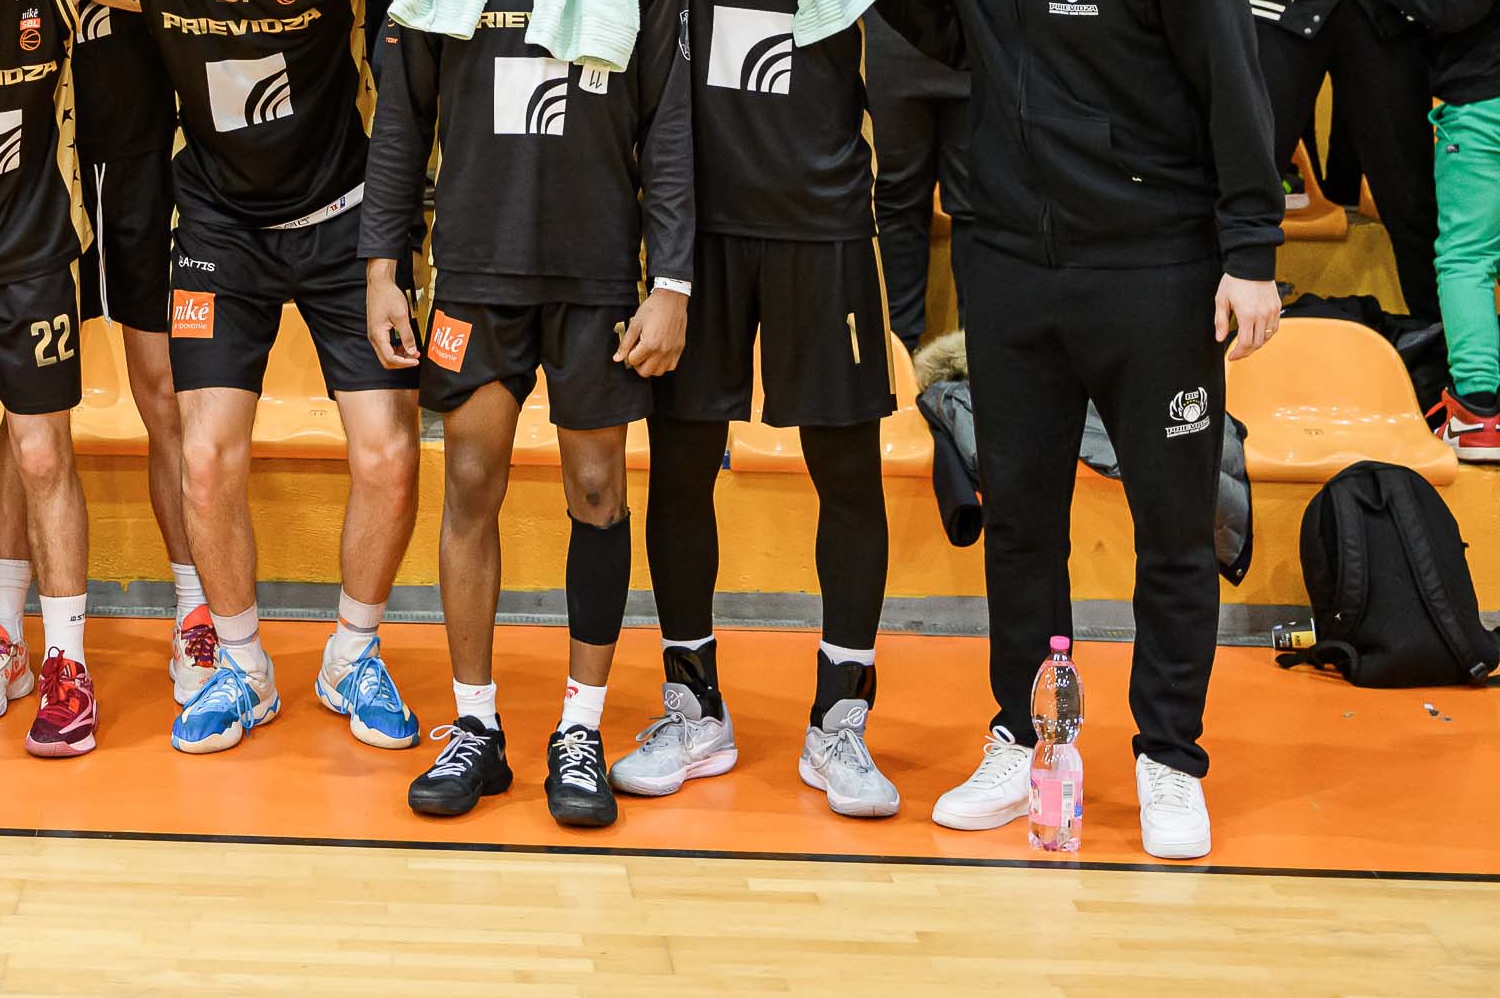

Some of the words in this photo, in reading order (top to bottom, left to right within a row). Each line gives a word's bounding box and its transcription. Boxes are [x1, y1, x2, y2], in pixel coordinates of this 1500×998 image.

[22, 7, 39, 20] niké
[1048, 3, 1098, 14] PRIEVIDZA
[21, 19, 40, 29] SBL
[161, 7, 322, 37] PRIEVIDZA
[174, 298, 210, 321] niké
[30, 313, 75, 368] 22
